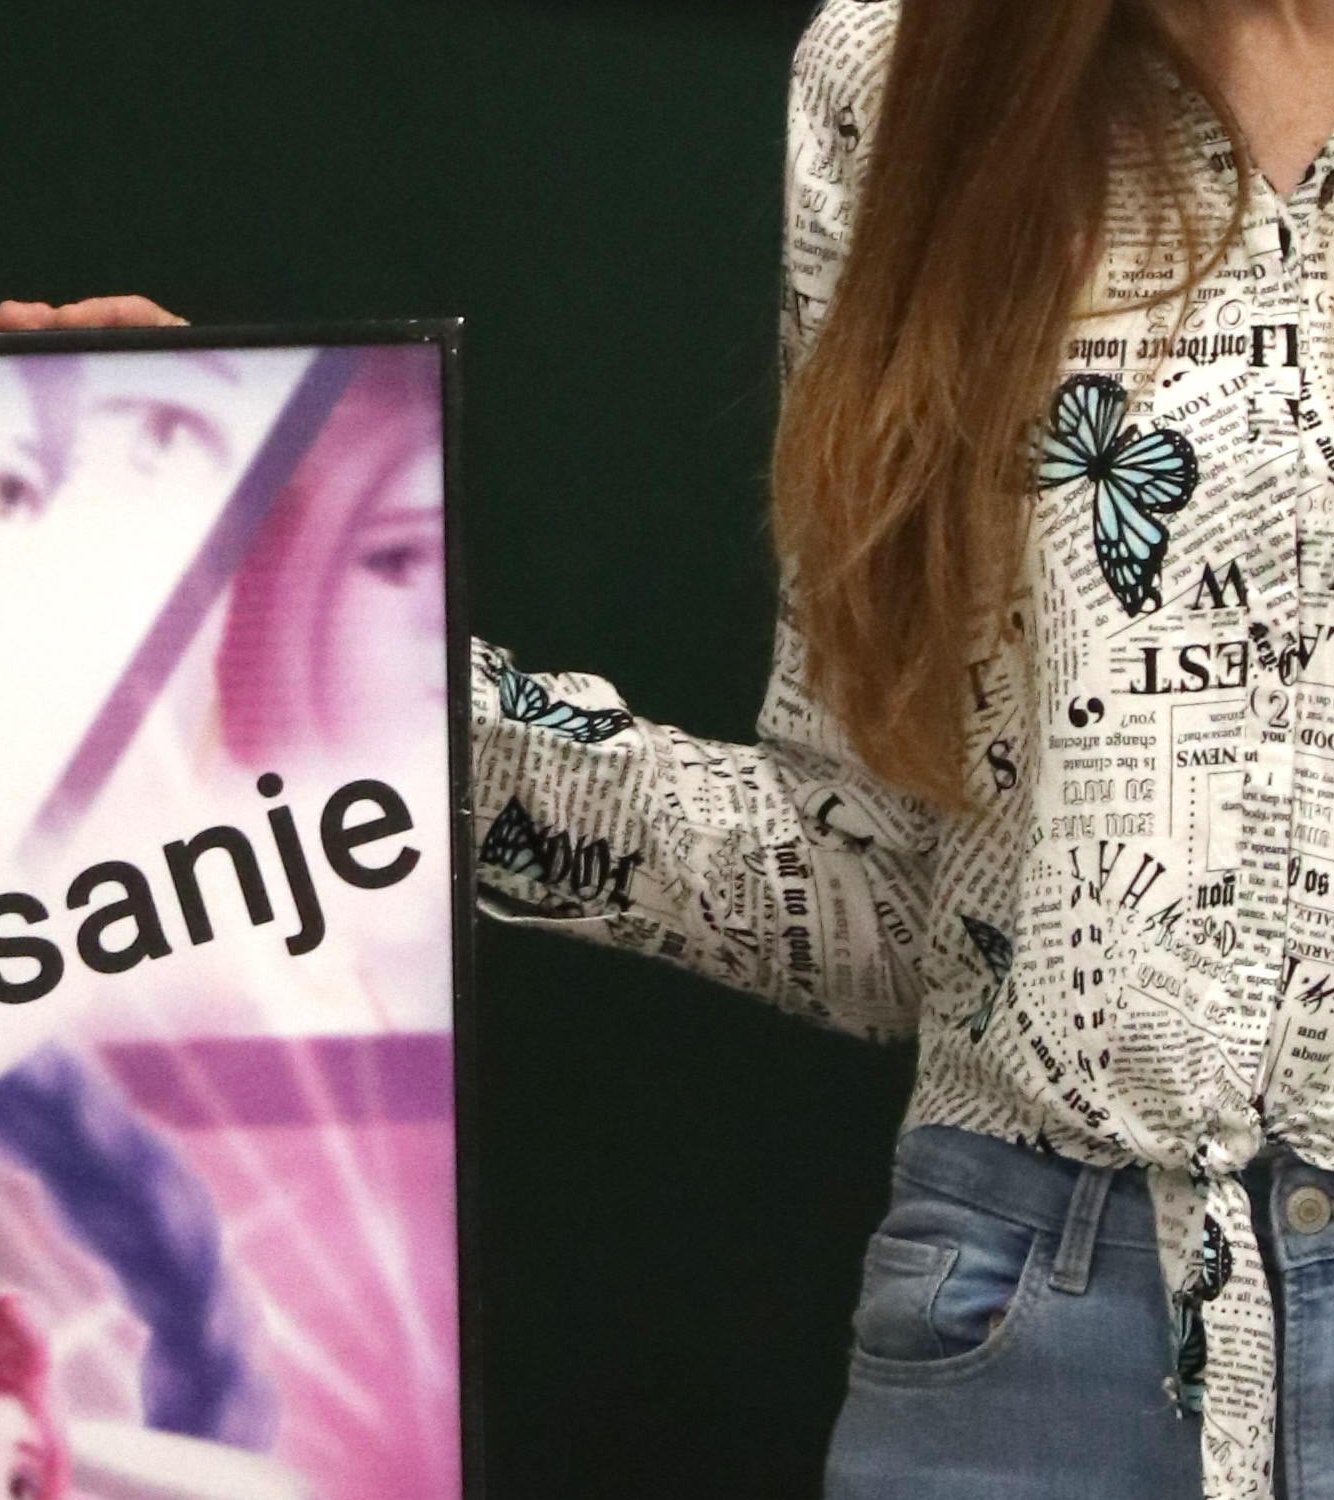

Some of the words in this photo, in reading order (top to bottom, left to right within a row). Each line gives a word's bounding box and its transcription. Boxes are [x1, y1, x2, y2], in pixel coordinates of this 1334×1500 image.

[1150, 393, 1212, 430] ENJOY
[1119, 710, 1156, 729] you?
[1105, 732, 1157, 750] change
[1062, 757, 1112, 772] climate
[1116, 757, 1138, 772] the
[1143, 757, 1156, 771] Is
[1176, 745, 1238, 768] NEWS
[1296, 1025, 1328, 1042] and
